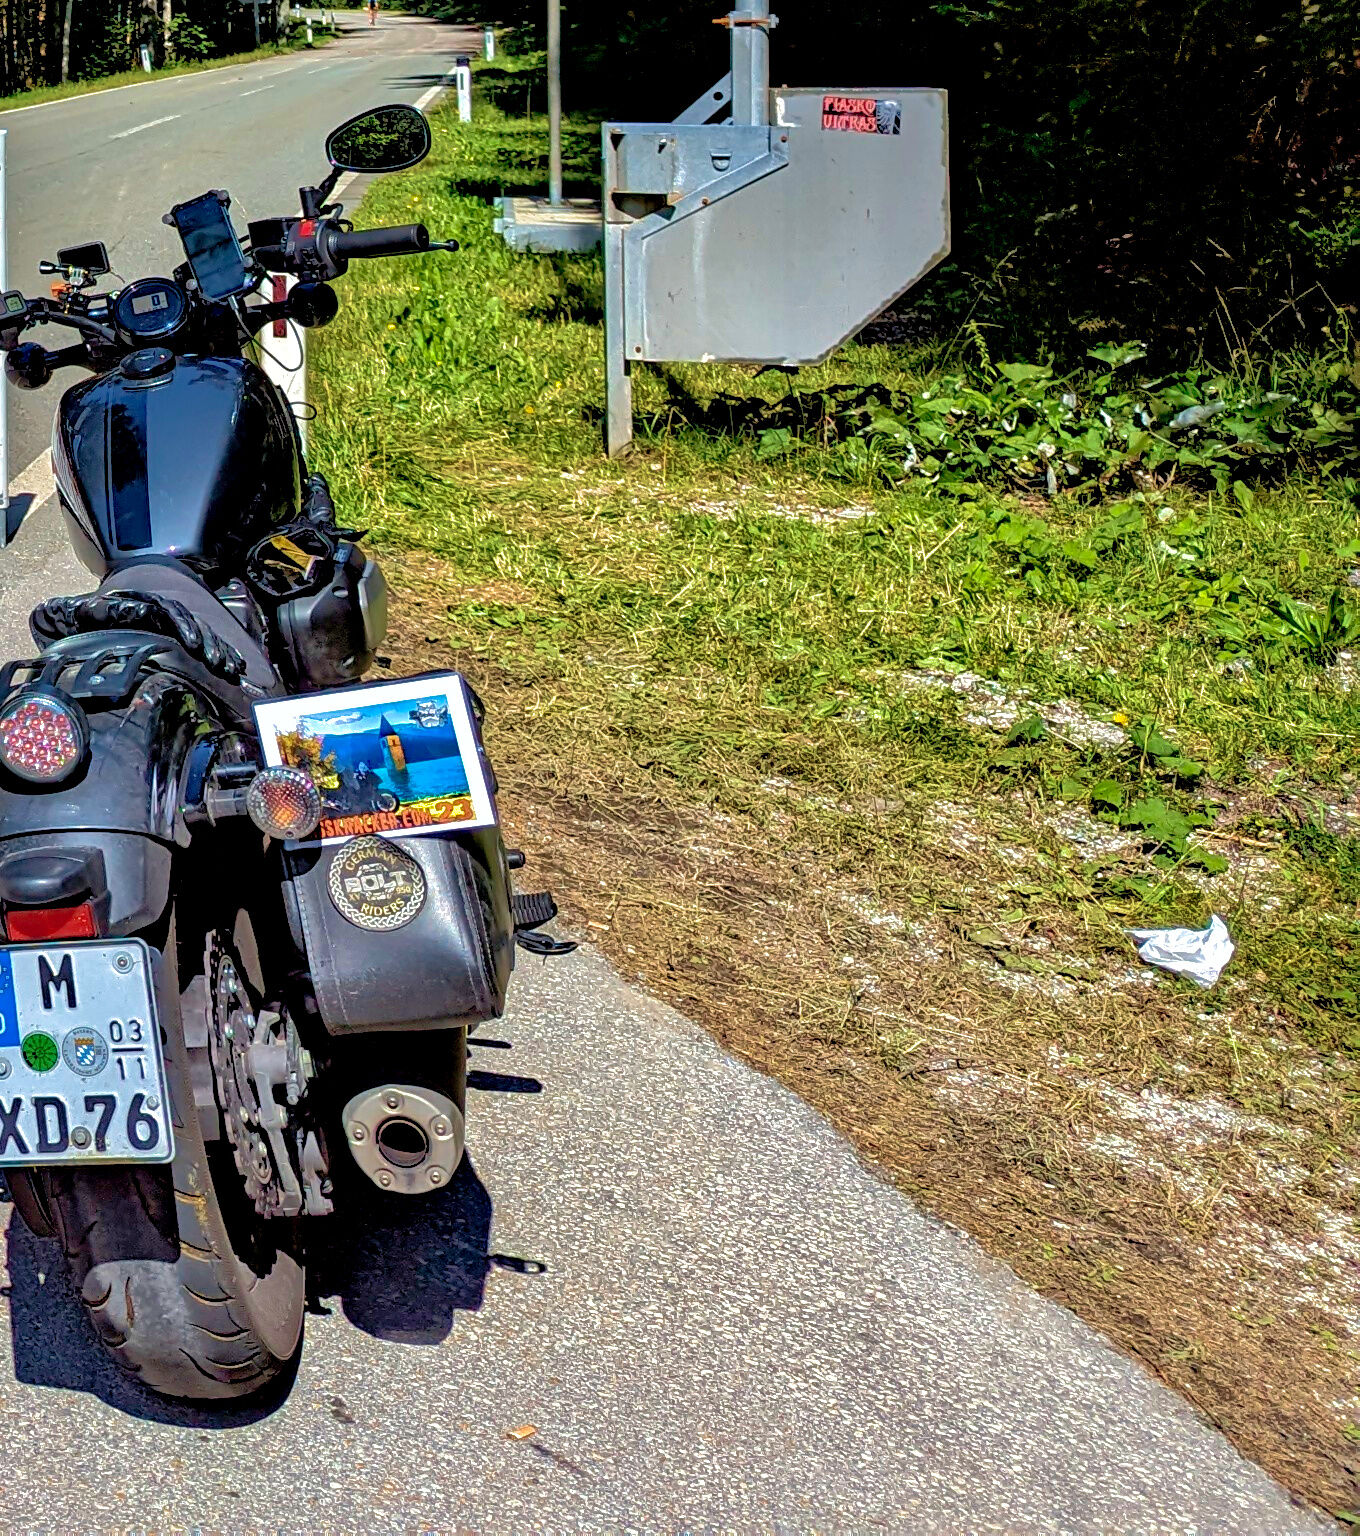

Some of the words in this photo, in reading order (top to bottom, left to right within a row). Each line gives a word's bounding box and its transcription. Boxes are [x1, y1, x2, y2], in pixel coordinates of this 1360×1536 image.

[345, 848, 398, 871] GERMAN
[344, 870, 406, 893] BOLT
[360, 898, 405, 916] RIDERS
[37, 953, 77, 1010] M
[109, 1019, 143, 1043] 03
[116, 1057, 145, 1080] 11
[84, 1093, 159, 1152] 76
